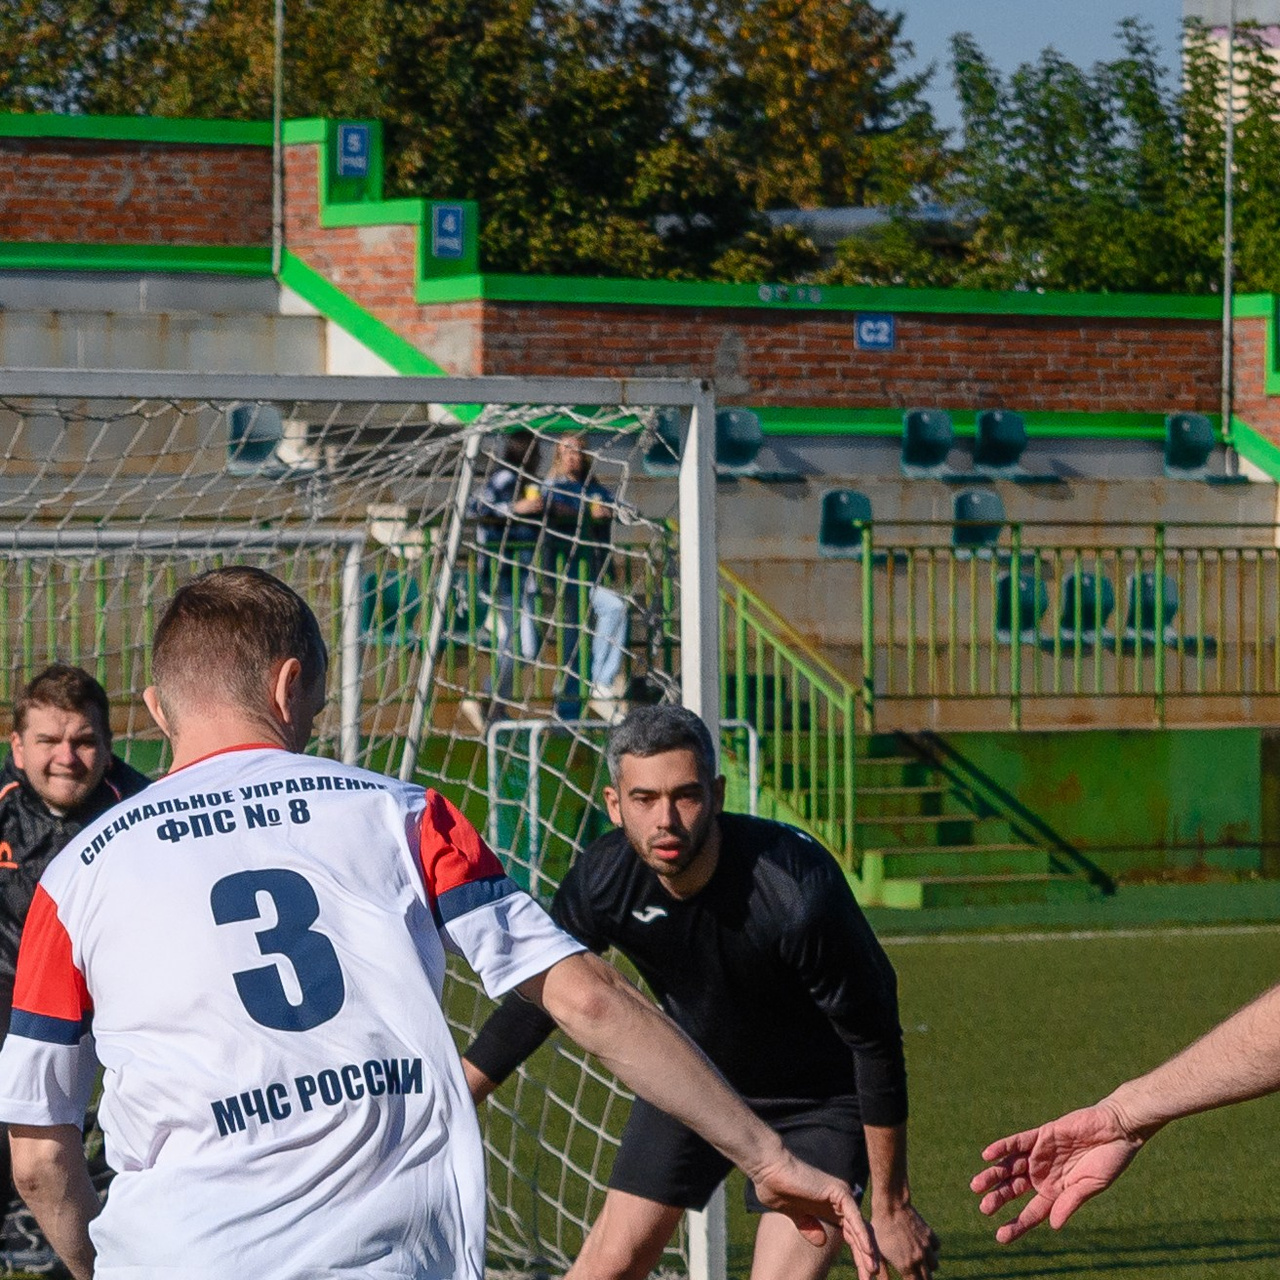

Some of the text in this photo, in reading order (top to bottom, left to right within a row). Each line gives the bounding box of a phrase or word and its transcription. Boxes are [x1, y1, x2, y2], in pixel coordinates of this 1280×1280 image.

[80, 789, 235, 866] СПЕЦИАЛЬНОЕ
[156, 809, 236, 843] ФПС
[288, 798, 311, 824] 8
[210, 868, 346, 1032] 3
[211, 1057, 424, 1137] МЧС РОССИИ
